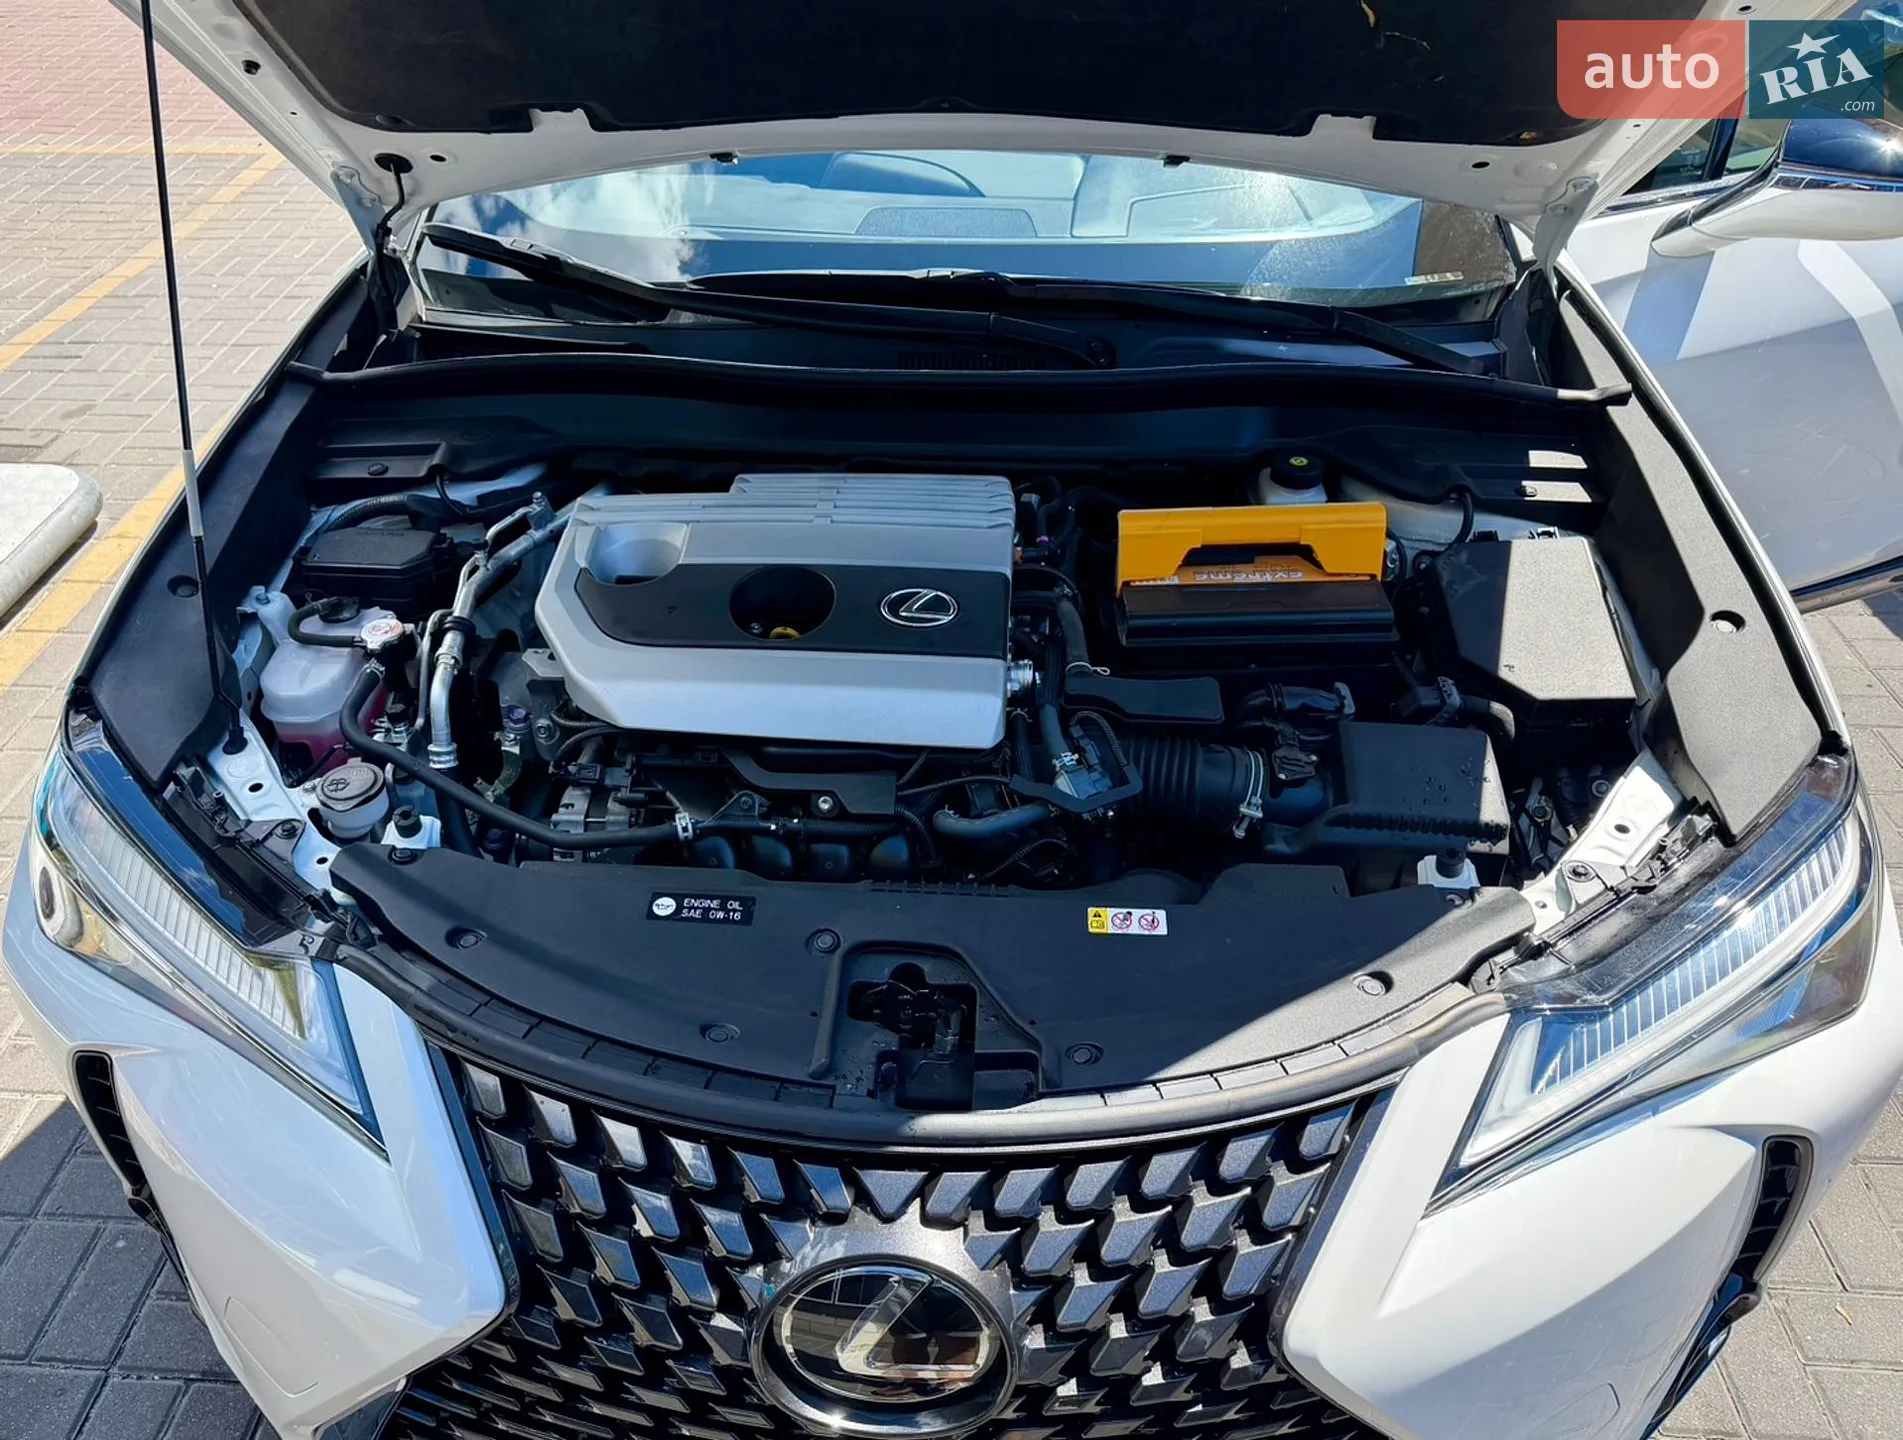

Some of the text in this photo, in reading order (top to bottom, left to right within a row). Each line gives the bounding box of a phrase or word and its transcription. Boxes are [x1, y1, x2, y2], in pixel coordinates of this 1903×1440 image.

[683, 897, 743, 910] ENGINE OIL
[681, 908, 742, 920] SAE 0W-16
